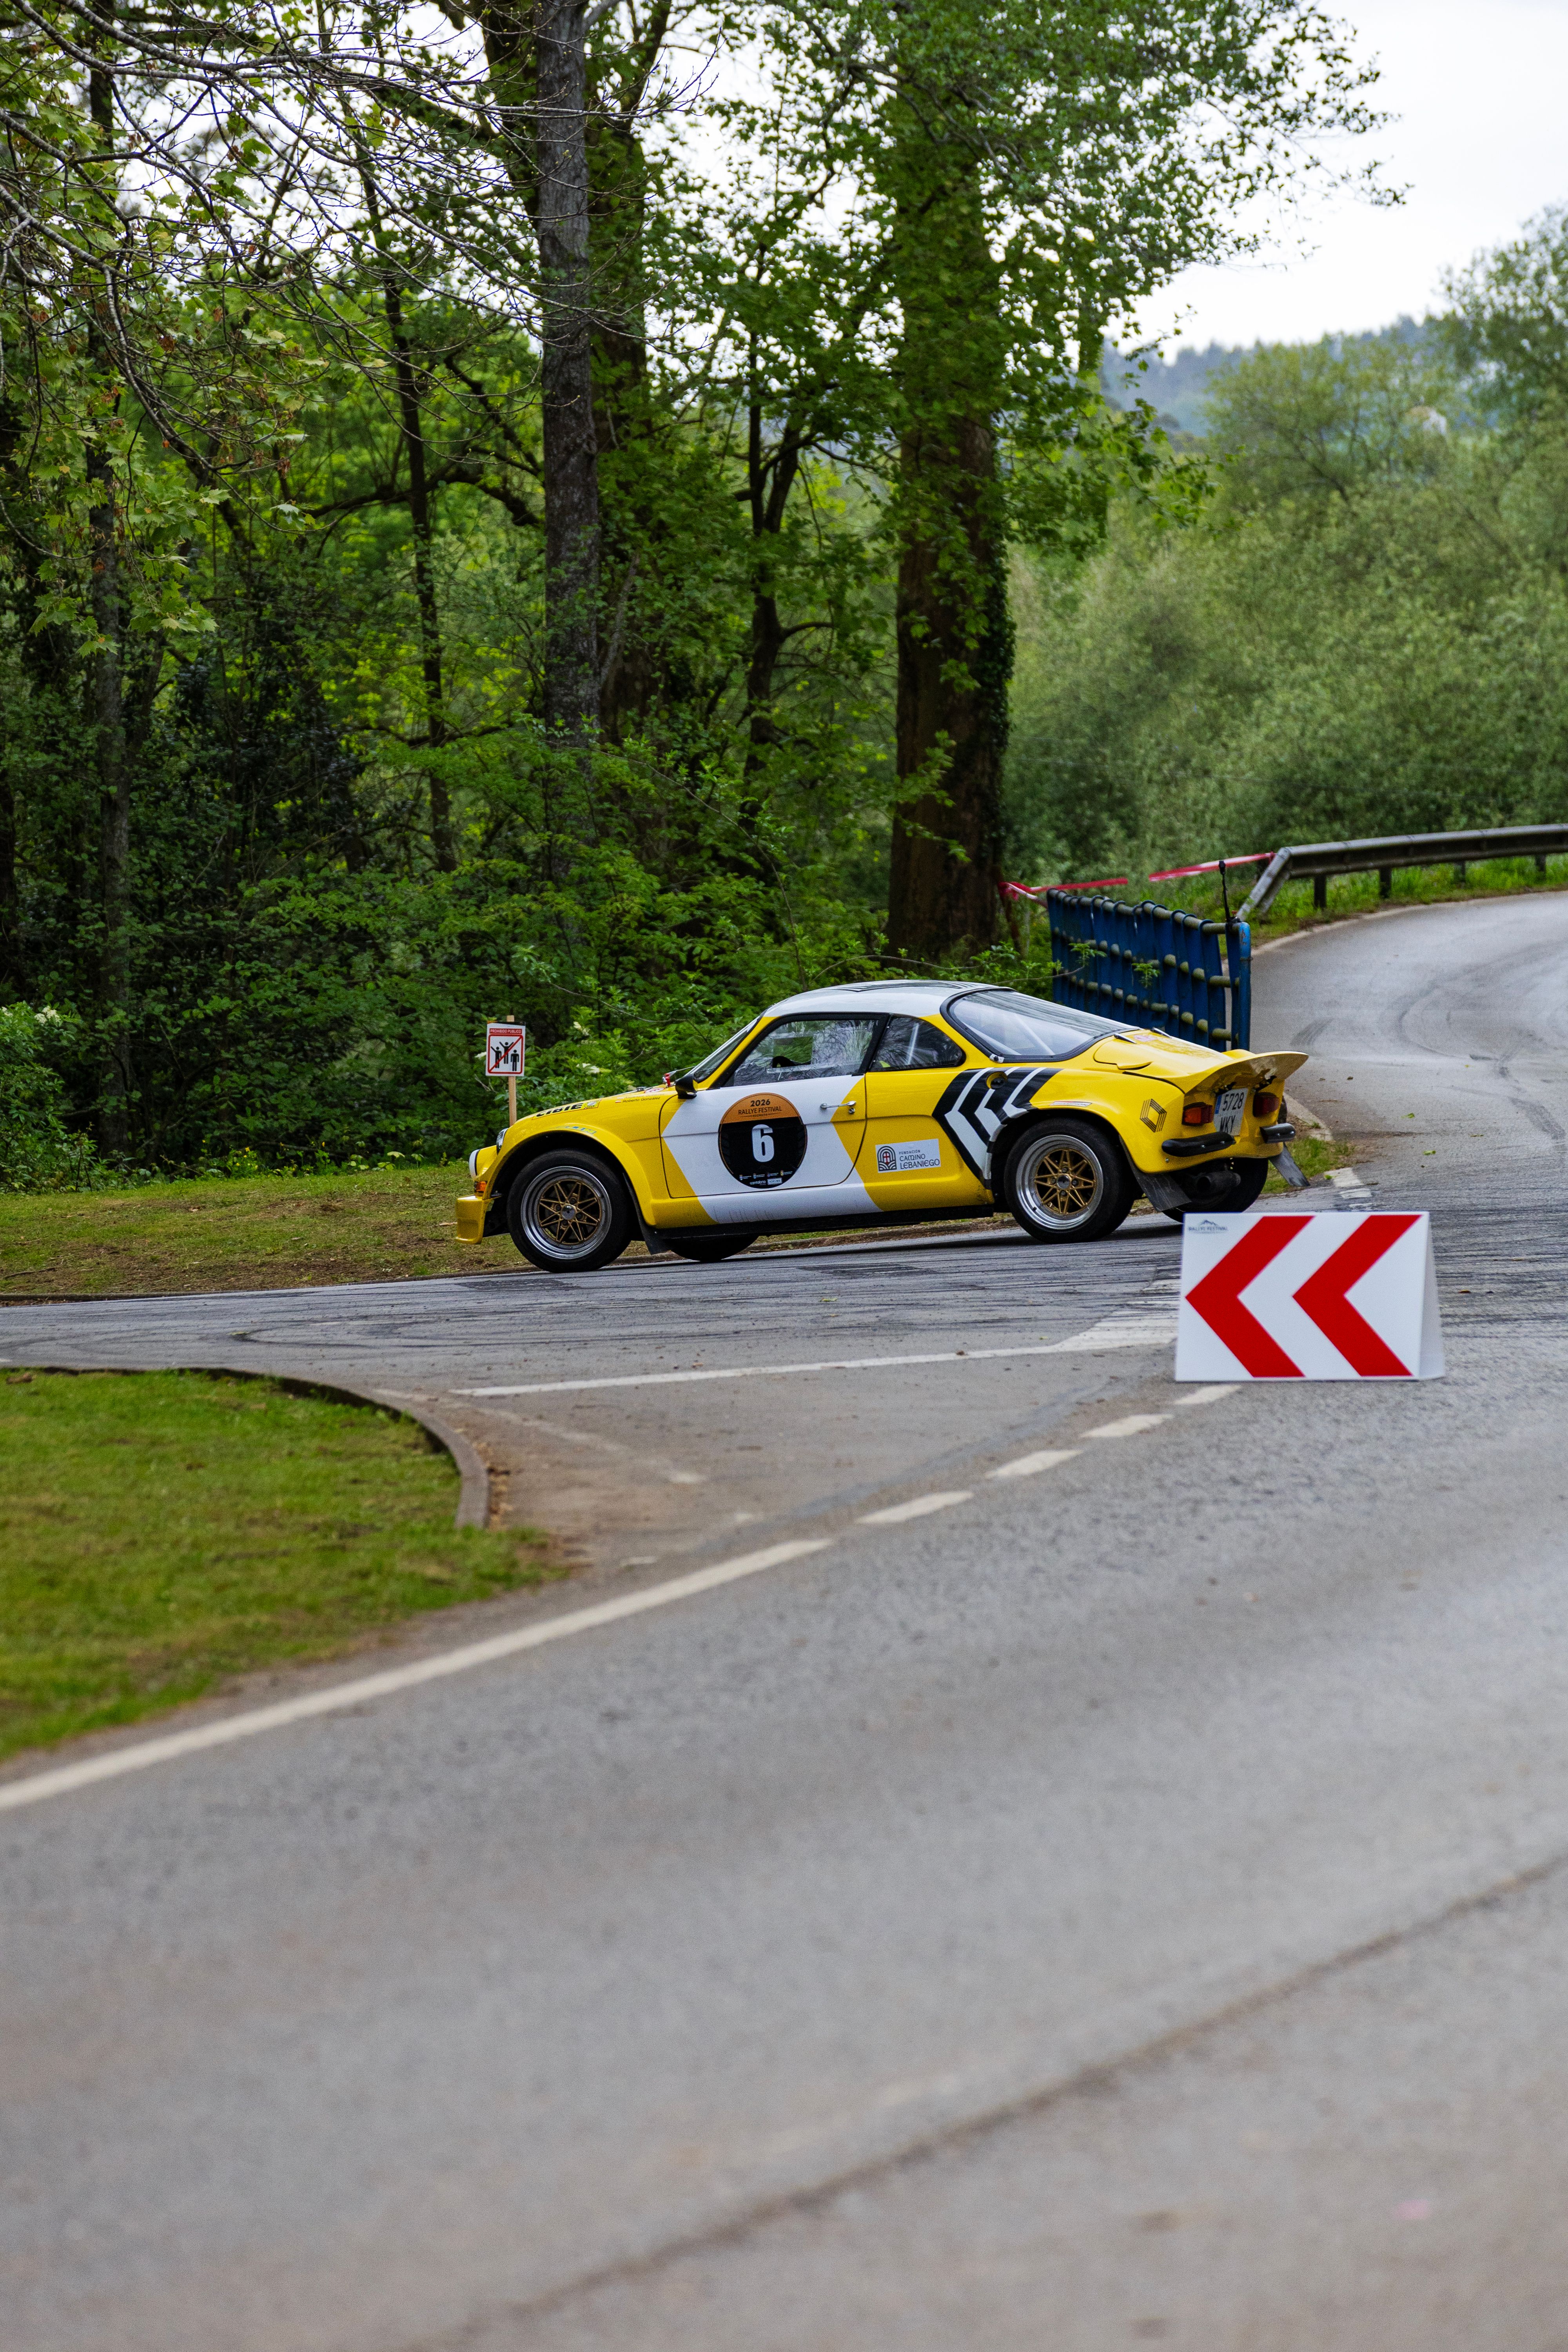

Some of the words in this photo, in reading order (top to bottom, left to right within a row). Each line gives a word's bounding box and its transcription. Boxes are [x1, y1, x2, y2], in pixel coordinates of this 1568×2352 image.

[1223, 1092, 1244, 1111] 5728
[752, 1124, 774, 1162] 6
[900, 1158, 940, 1169] LEBANIEGO
